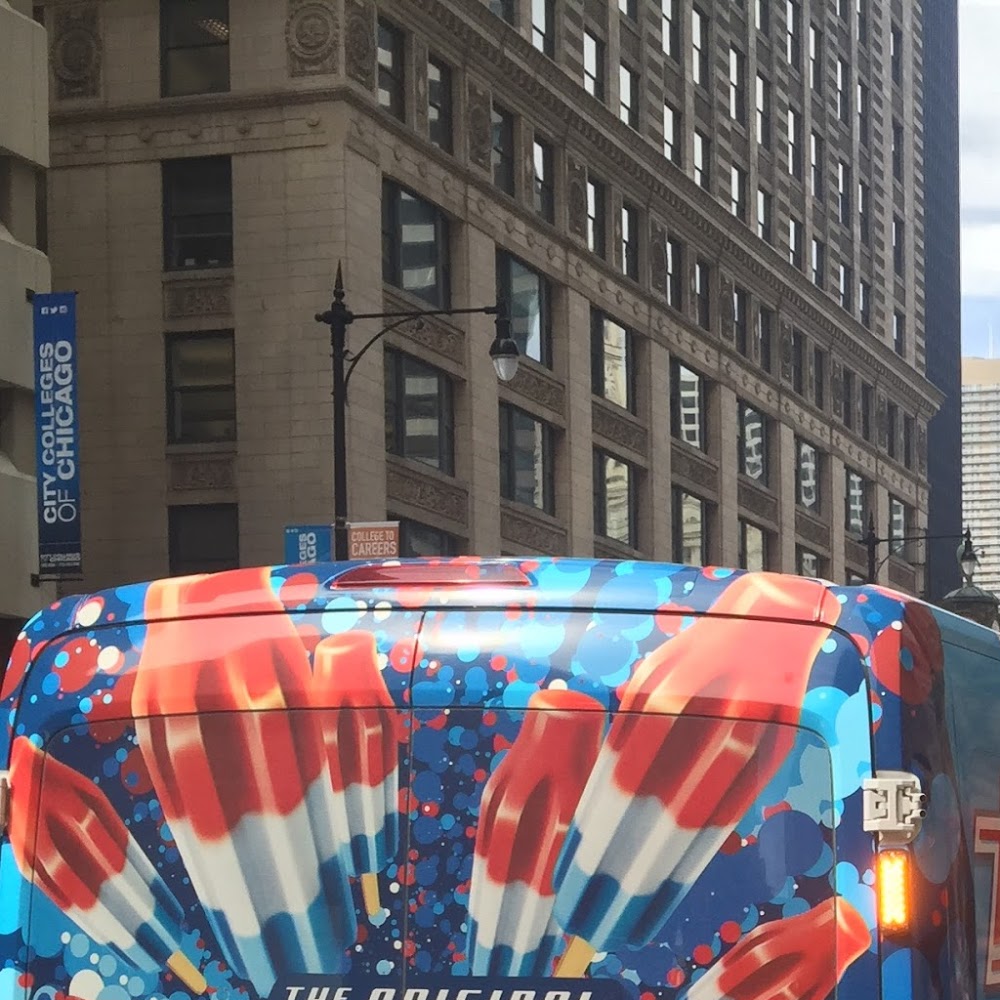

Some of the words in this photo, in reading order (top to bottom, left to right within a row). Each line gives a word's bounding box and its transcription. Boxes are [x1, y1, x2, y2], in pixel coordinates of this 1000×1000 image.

[39, 342, 55, 466] COLLEGES
[54, 340, 75, 480] CHICAGO
[43, 472, 57, 524] CITY
[57, 489, 76, 522] OF
[351, 531, 384, 542] COLLEGE
[385, 530, 395, 541] TO
[351, 541, 397, 556] CAREERS
